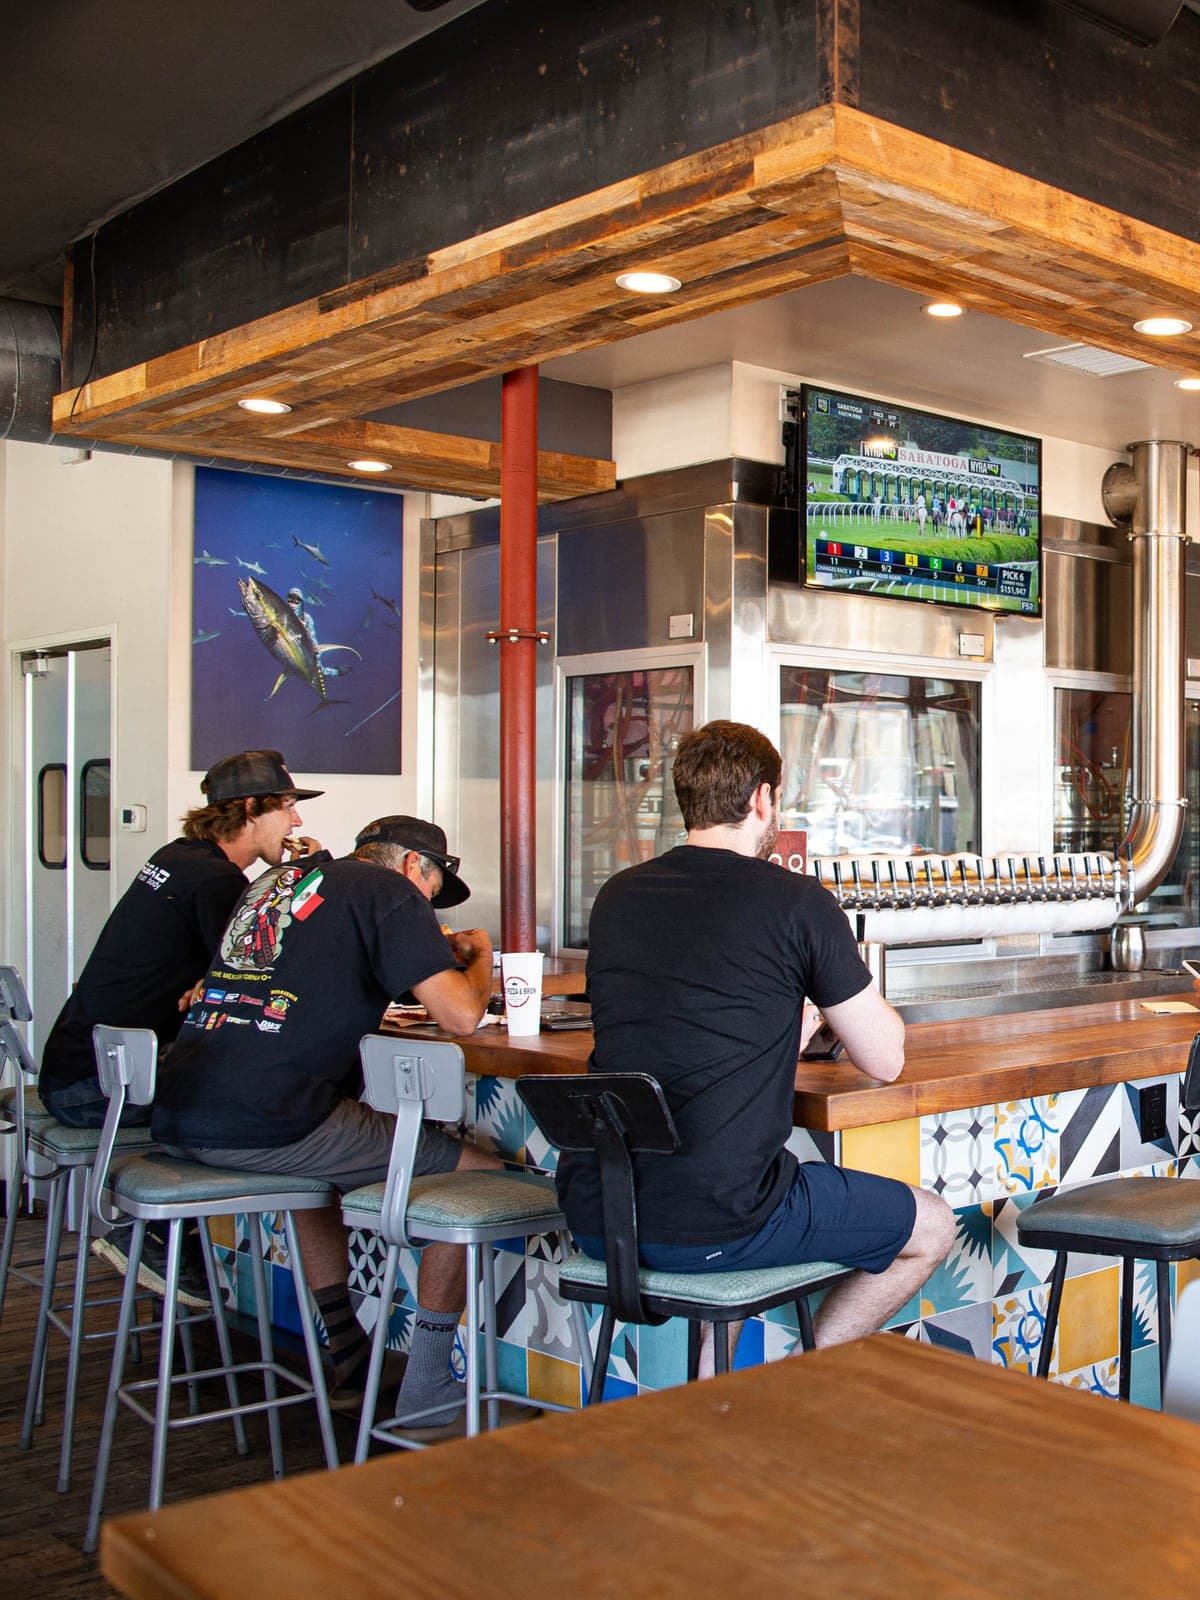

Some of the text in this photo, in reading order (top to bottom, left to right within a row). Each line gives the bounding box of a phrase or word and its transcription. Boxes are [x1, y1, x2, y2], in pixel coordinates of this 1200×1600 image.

[837, 403, 863, 414] SARATOGA
[900, 449, 967, 470] SARATOGA
[970, 461, 987, 474] NYRA
[858, 547, 864, 558] 2
[884, 551, 890, 562] 3
[956, 562, 962, 572] 6
[830, 557, 838, 565] 11
[881, 564, 892, 573] 9/2
[977, 578, 987, 587] Scr
[1002, 570, 1025, 581] PICK 6
[1021, 601, 1034, 611] FS2
